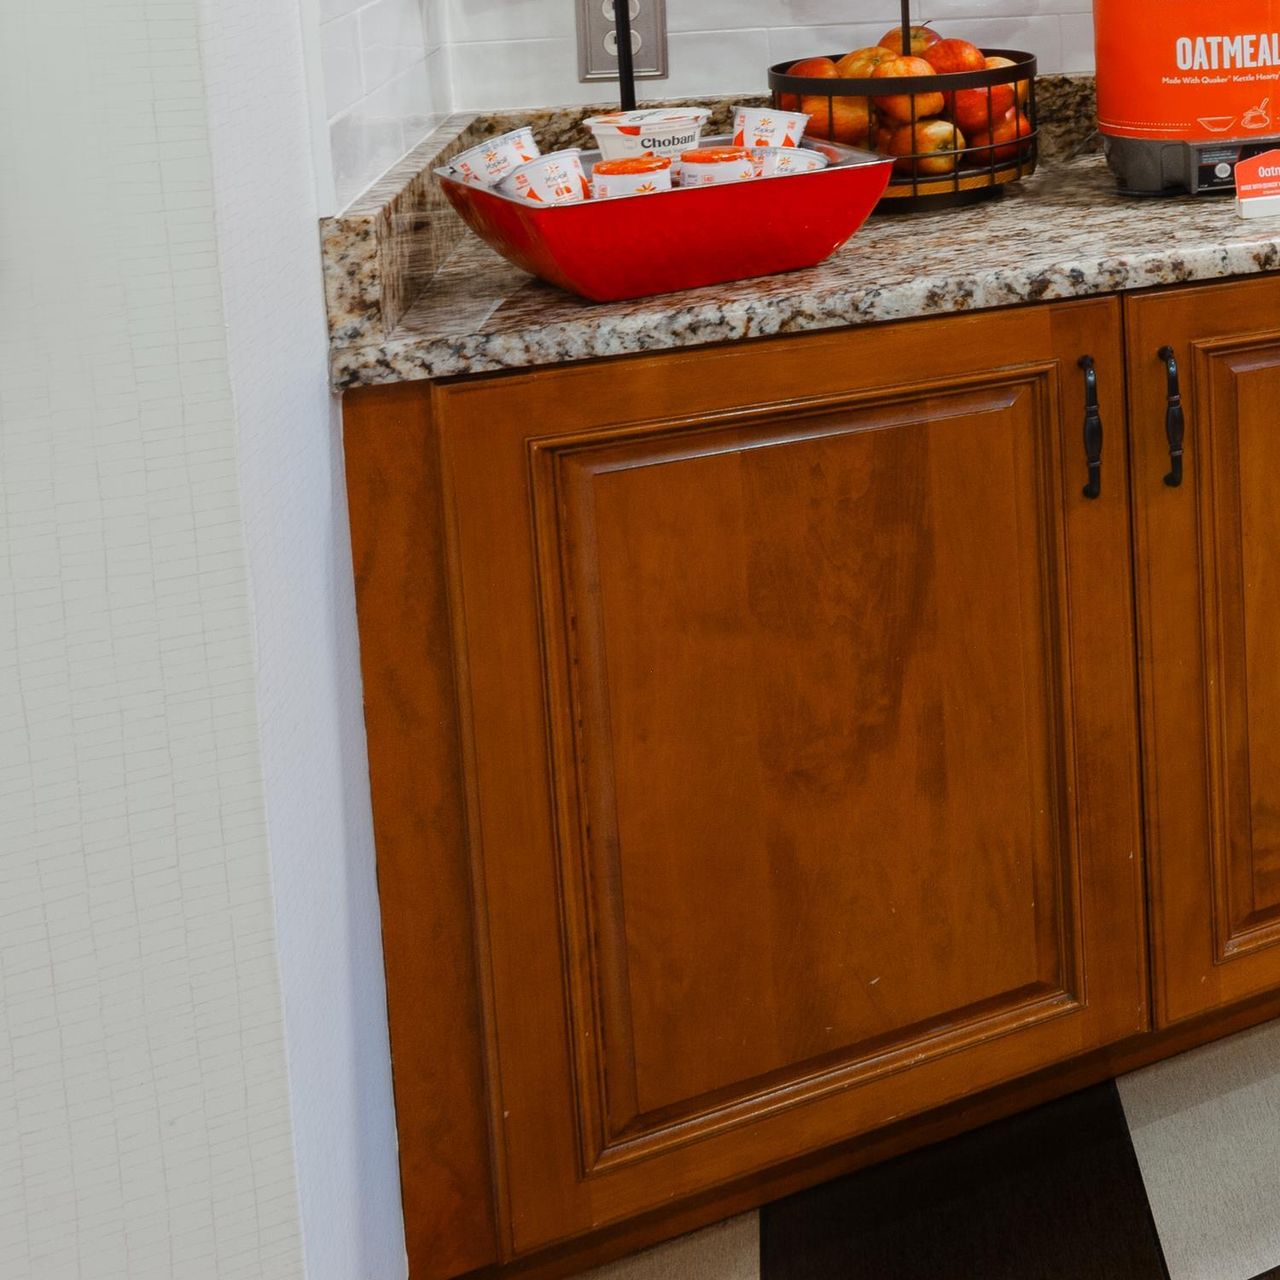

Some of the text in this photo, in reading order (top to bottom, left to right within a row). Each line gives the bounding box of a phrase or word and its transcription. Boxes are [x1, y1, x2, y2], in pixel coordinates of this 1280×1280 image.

[1162, 77, 1181, 85] Made
[1182, 76, 1200, 84] With
[1233, 74, 1256, 82] Kettle
[641, 131, 696, 148] Chobani
